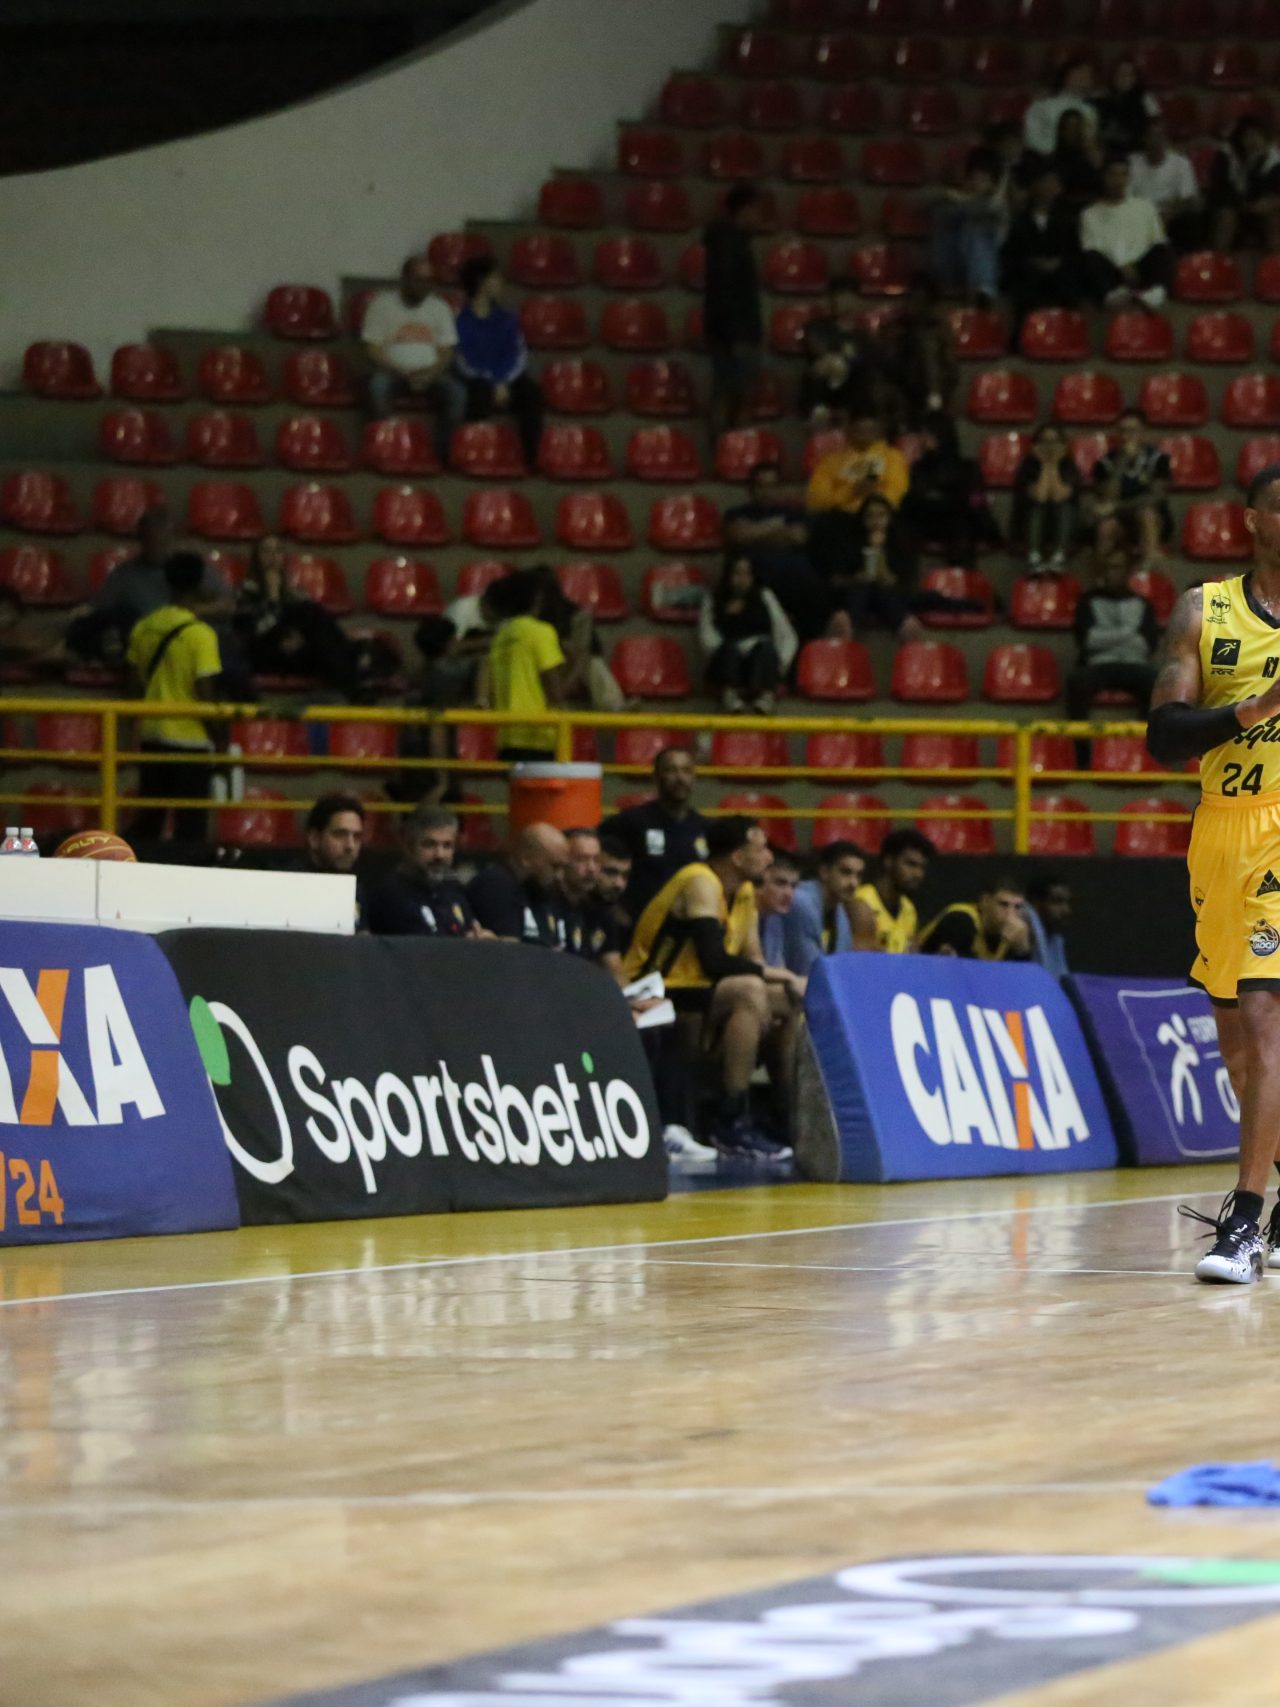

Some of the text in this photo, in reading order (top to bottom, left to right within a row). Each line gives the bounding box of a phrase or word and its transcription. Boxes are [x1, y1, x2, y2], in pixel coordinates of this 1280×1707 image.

[61, 836, 113, 855] ALTY
[1221, 762, 1264, 797] 24
[0, 963, 166, 1127] XA
[287, 1044, 650, 1195] Sportsbet.io
[889, 992, 1090, 1151] CAIXA
